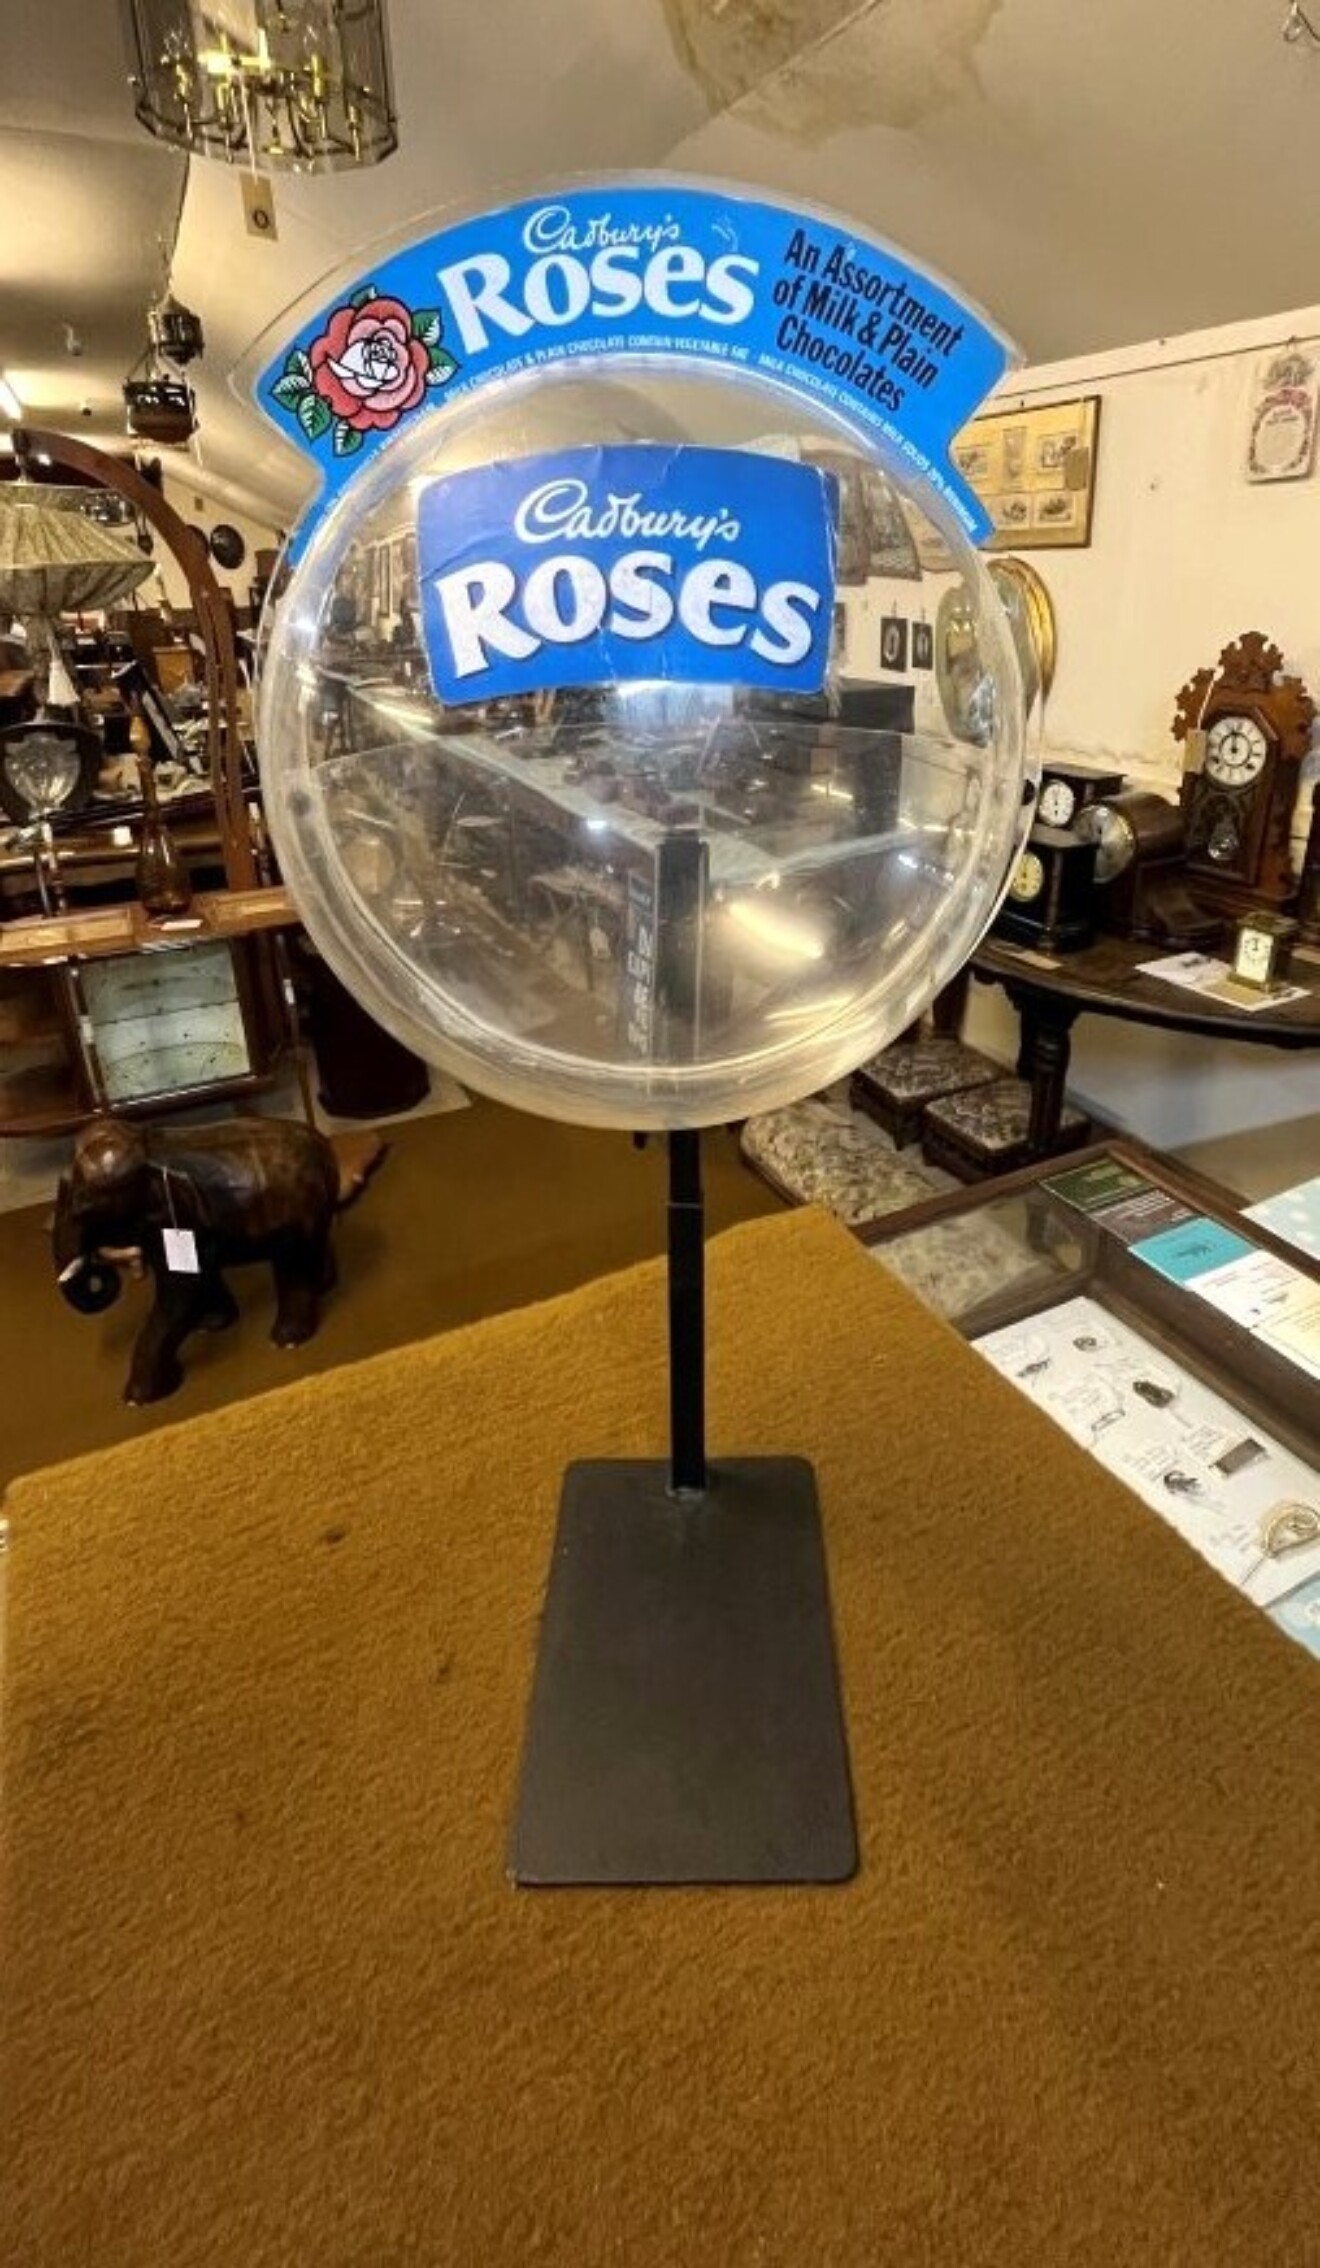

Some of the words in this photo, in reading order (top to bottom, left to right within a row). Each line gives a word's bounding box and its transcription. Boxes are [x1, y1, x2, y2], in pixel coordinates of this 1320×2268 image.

[523, 204, 681, 252] Cadbury's
[436, 245, 760, 355] Roses
[773, 275, 807, 311] of
[802, 280, 861, 336] Milk
[857, 311, 882, 350] &
[878, 322, 939, 389] Plain
[785, 228, 822, 273] An
[822, 244, 965, 357] Assortment
[776, 313, 906, 412] Chocolates
[514, 478, 741, 552] Cadbury's
[434, 550, 821, 680] Roses
